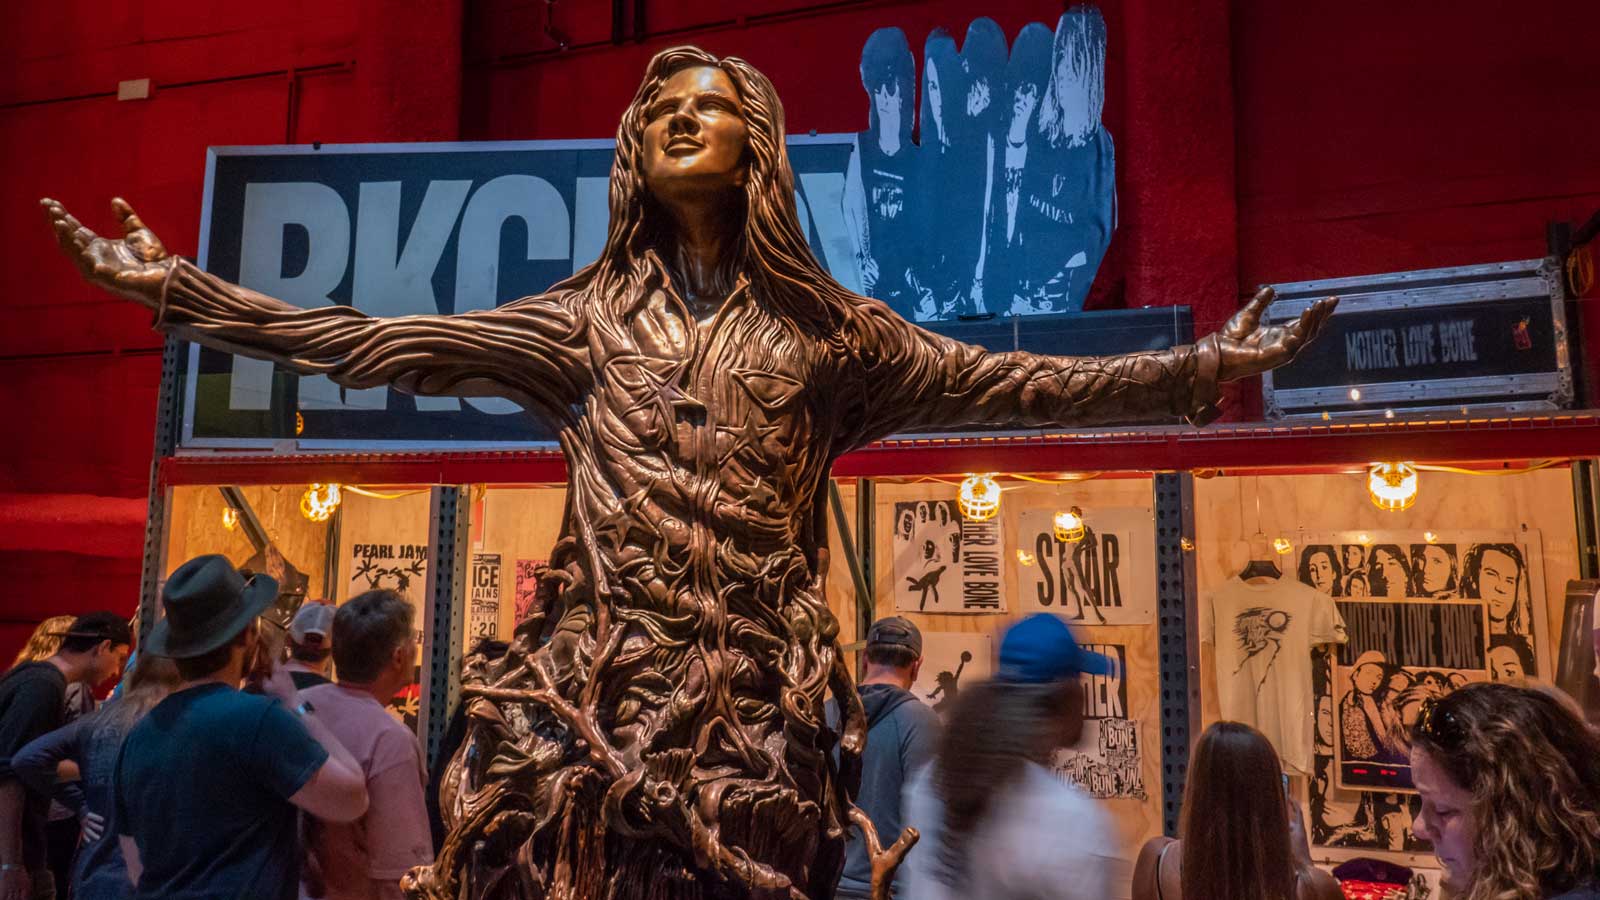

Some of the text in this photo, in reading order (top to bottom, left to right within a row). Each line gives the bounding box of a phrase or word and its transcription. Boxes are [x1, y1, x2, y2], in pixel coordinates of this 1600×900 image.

[1345, 320, 1478, 371] MOTHER LOVE BONE
[353, 544, 428, 560] PEARL JAM
[962, 551, 999, 577] LOVE
[473, 565, 499, 588] ICE
[472, 588, 498, 599] AINS
[962, 582, 1000, 609] BONE
[1401, 603, 1438, 668] LOVE
[1440, 604, 1480, 669] BONE
